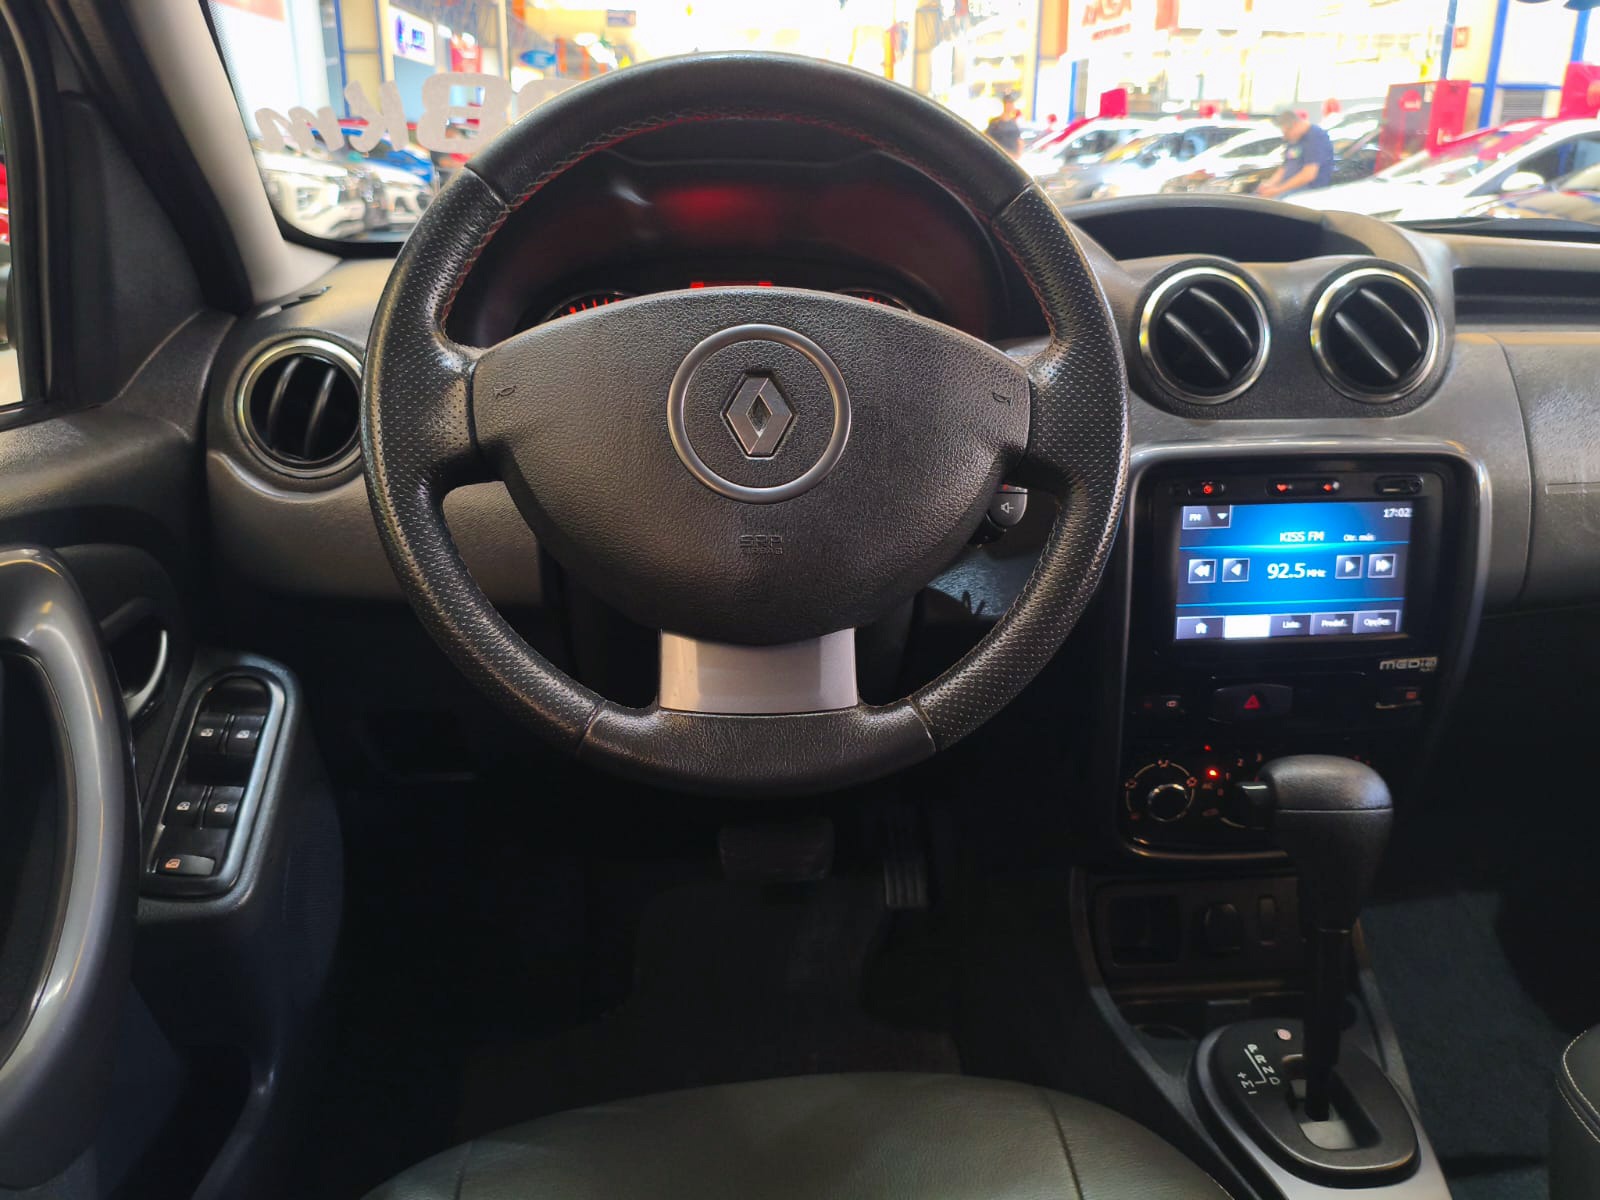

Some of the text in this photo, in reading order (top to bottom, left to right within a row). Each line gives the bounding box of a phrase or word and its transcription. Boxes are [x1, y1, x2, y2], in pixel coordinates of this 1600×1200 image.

[1383, 507, 1412, 518] 17:02
[1279, 530, 1325, 542] KISS FM
[1267, 562, 1306, 579] 92.5
